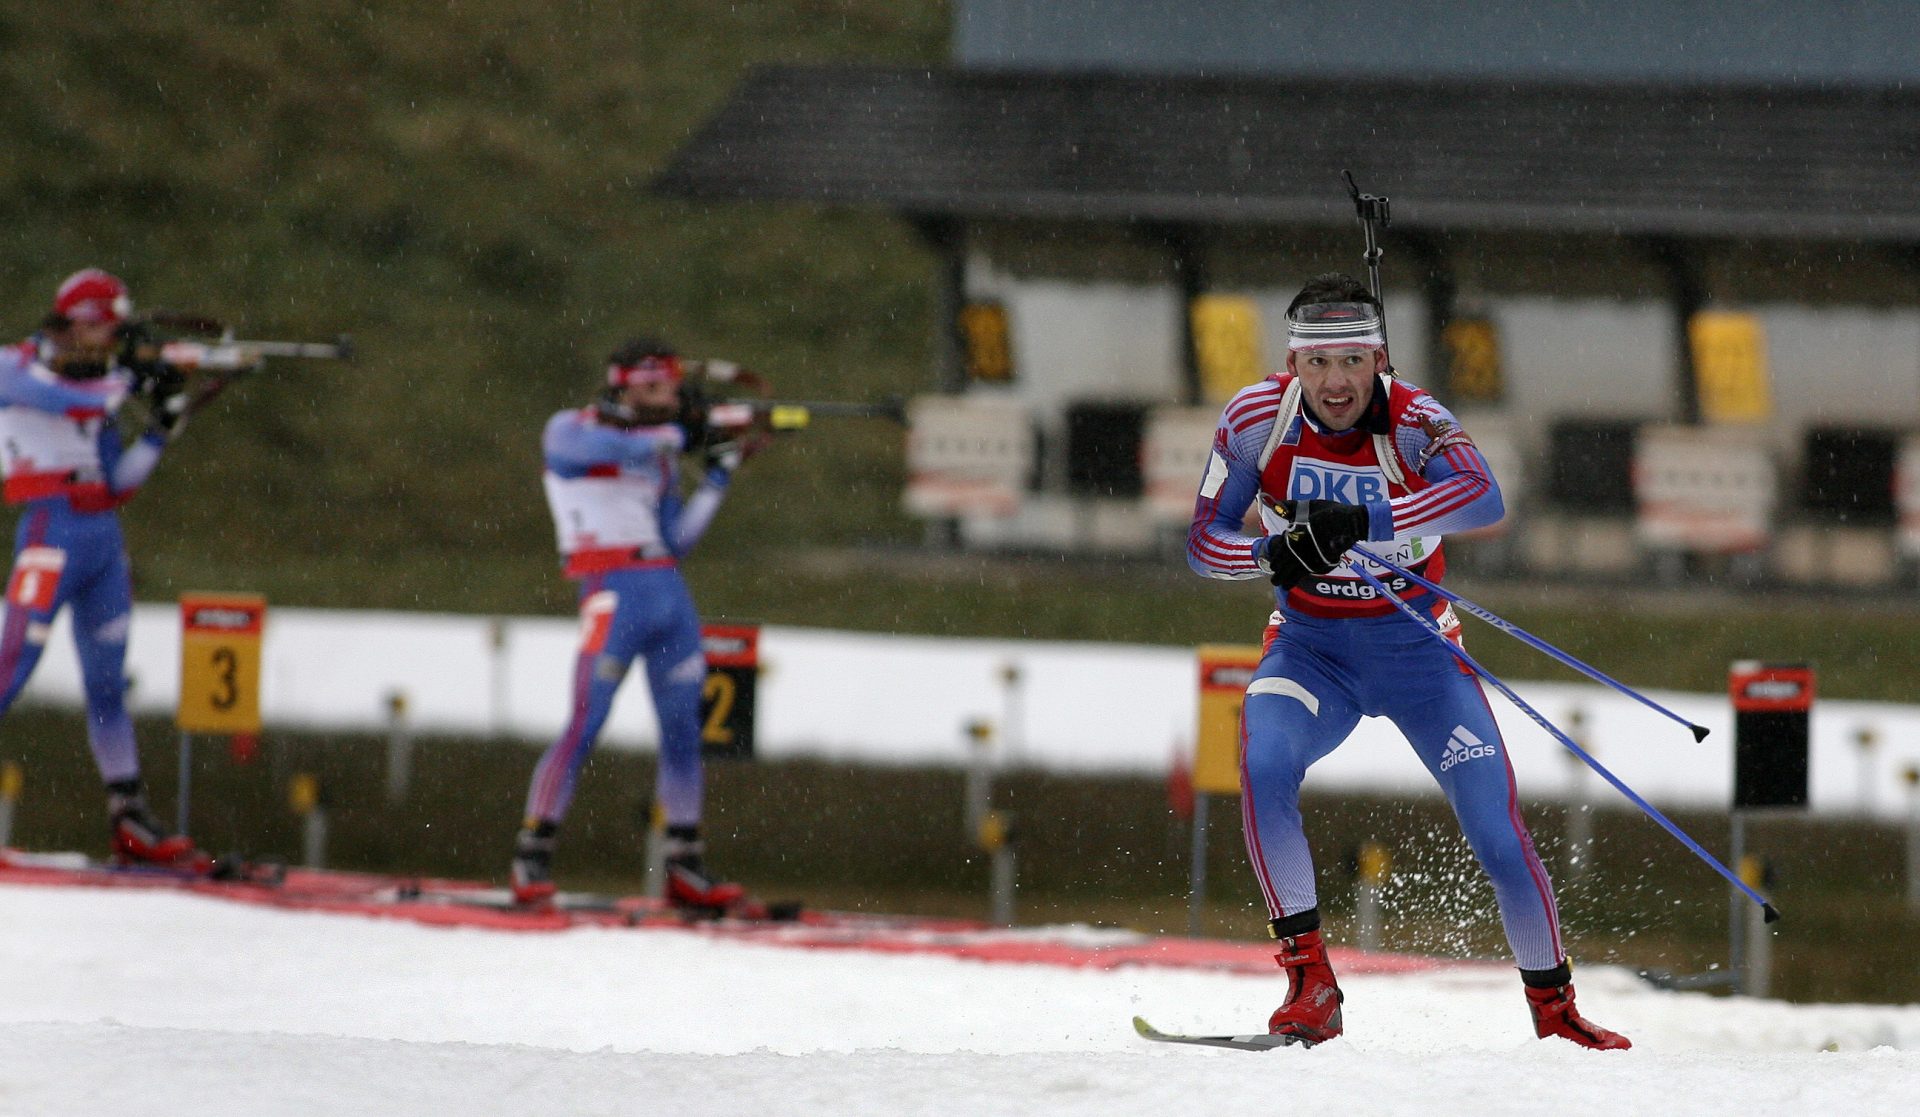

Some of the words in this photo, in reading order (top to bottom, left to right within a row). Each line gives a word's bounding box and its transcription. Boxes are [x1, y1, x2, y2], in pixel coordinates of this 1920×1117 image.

[1291, 467, 1384, 506] DKB
[211, 646, 238, 712] 3
[701, 671, 737, 745] 2
[1440, 744, 1496, 772] adidas
